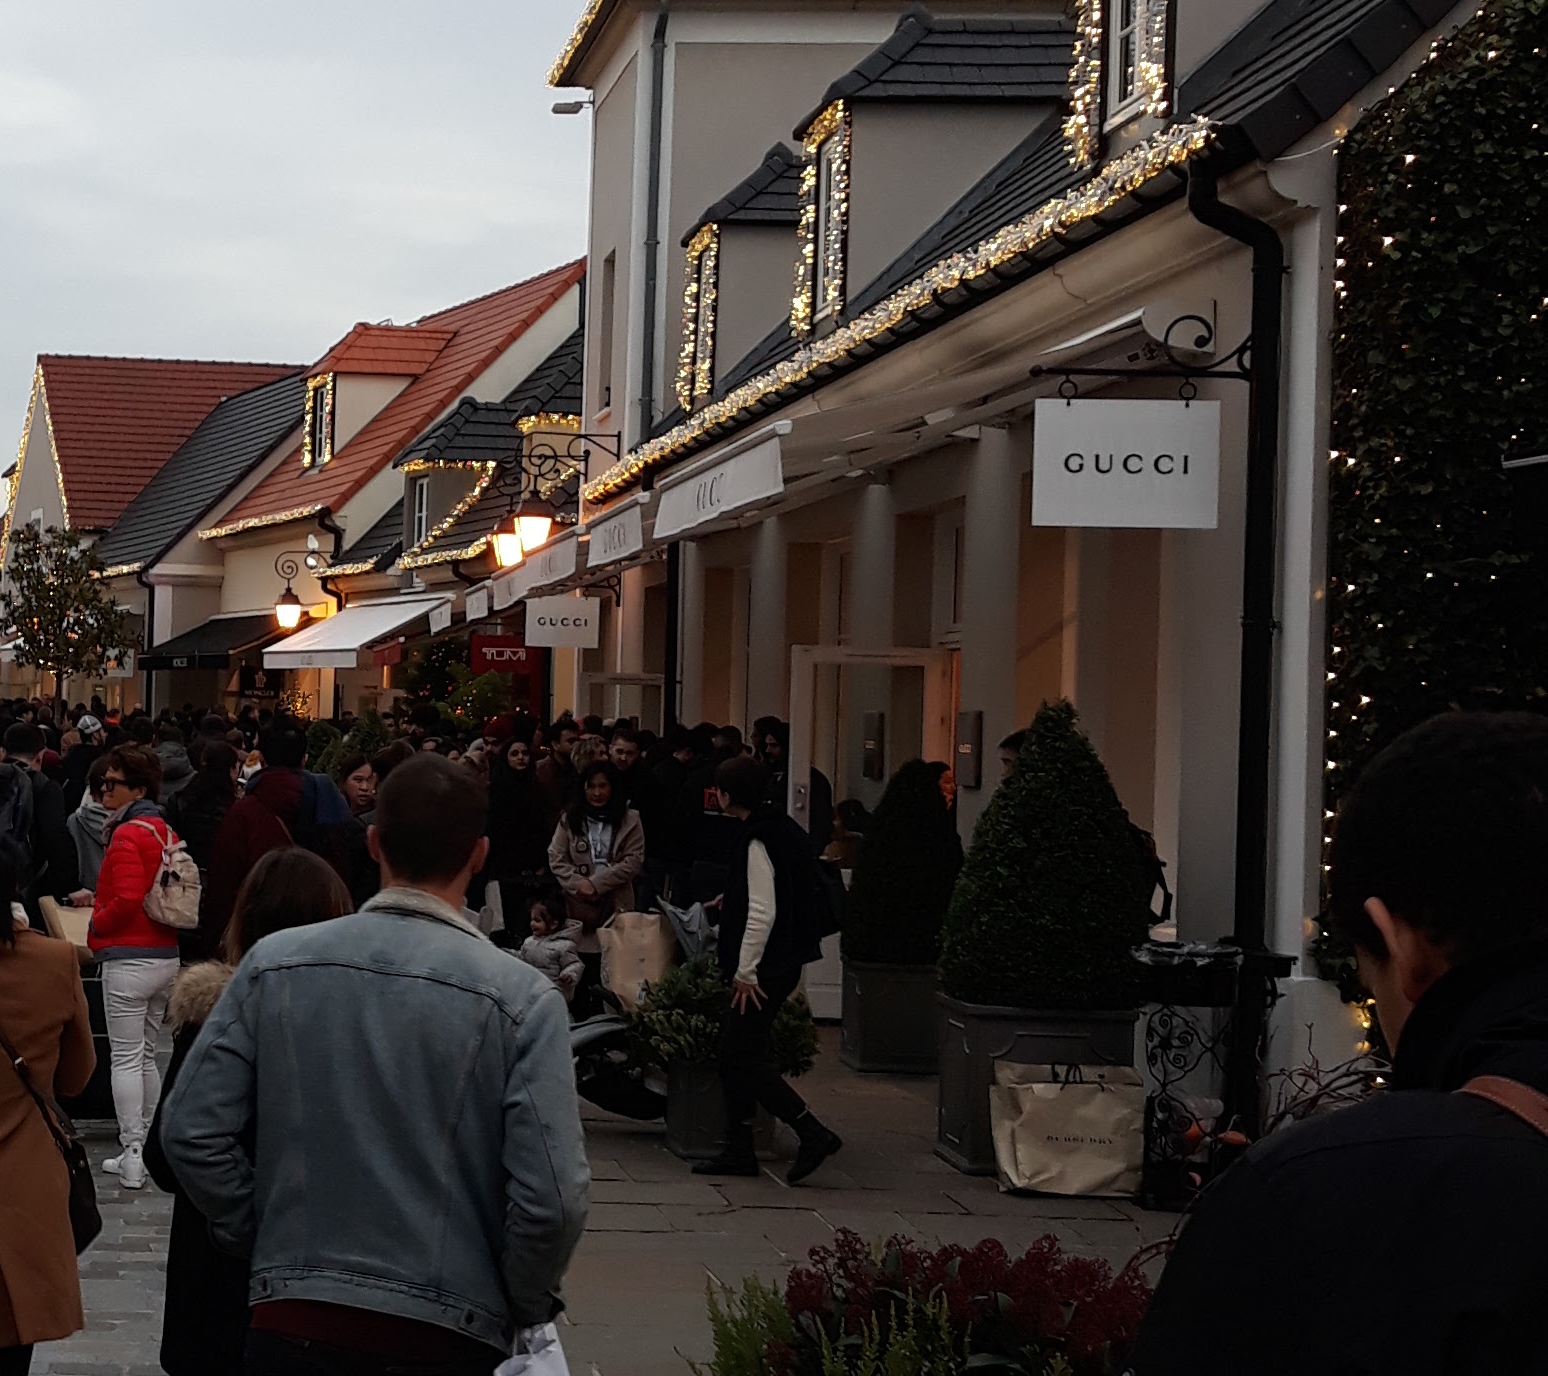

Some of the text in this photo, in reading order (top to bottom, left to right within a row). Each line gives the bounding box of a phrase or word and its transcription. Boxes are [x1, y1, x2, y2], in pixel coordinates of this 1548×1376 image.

[1064, 453, 1189, 475] GUCCI
[537, 616, 589, 627] GUCCI
[482, 647, 526, 661] TUMI
